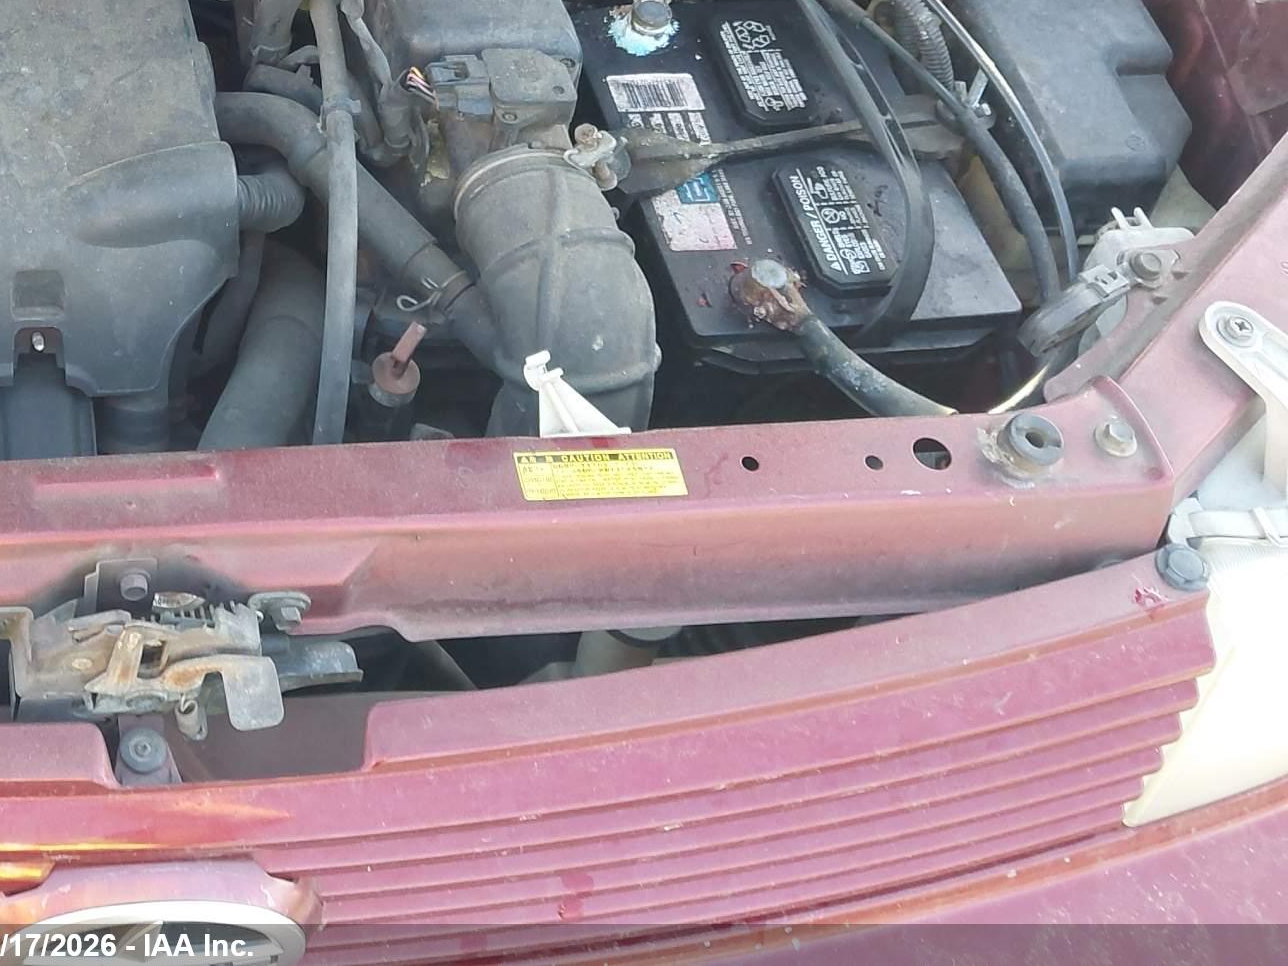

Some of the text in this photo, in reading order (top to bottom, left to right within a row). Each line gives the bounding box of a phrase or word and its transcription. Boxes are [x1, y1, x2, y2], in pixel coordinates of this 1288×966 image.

[789, 175, 814, 211] POISON
[810, 220, 839, 261] DANGER
[561, 453, 610, 463] CAUTION
[618, 451, 672, 461] ATTENTION
